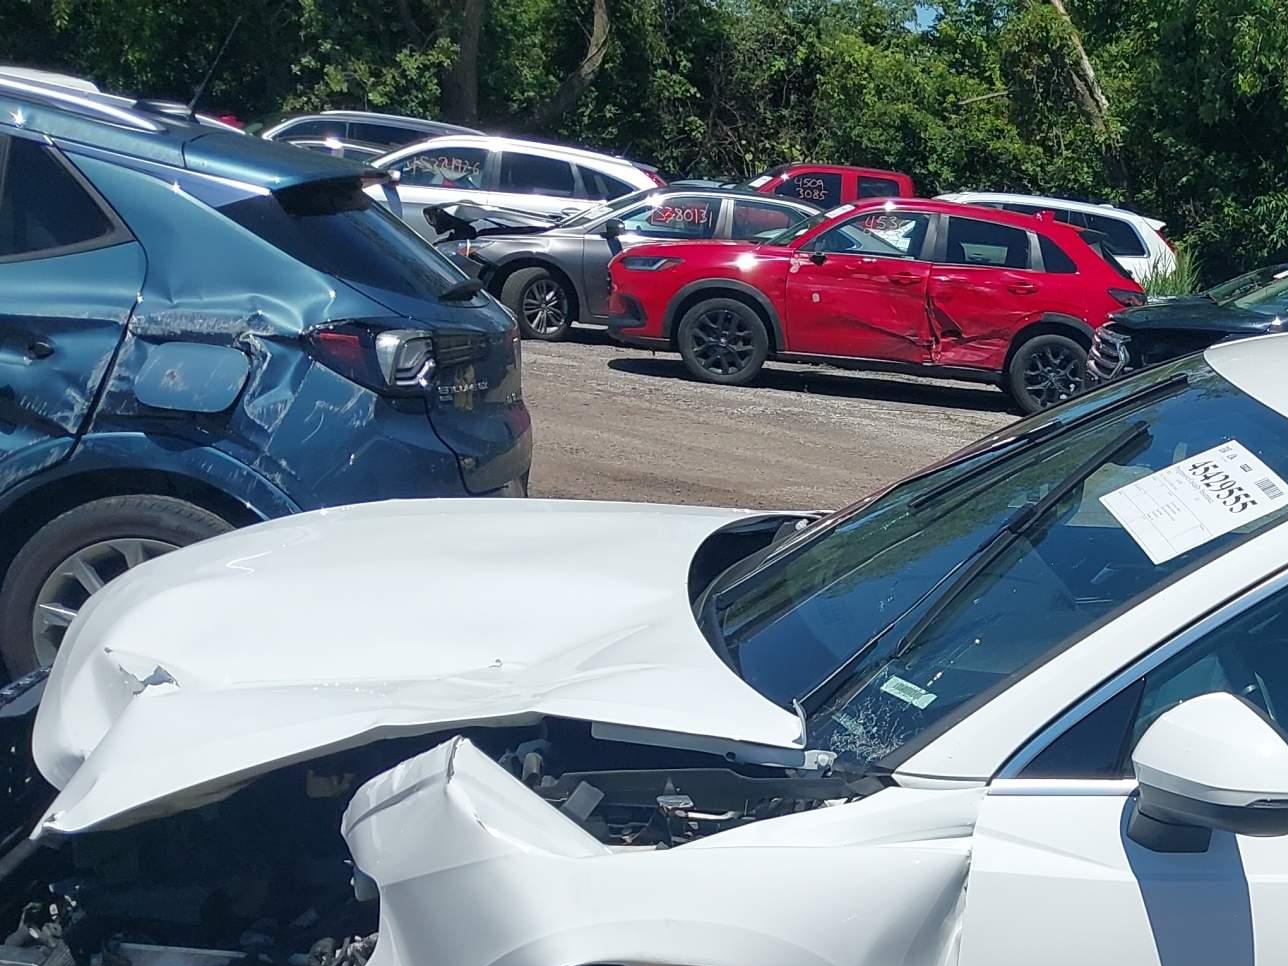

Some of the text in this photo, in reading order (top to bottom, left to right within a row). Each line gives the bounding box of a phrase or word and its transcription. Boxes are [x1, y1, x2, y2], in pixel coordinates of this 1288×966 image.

[794, 177, 824, 190] 4509
[796, 187, 829, 201] 3085
[1188, 460, 1258, 514] 45429555
